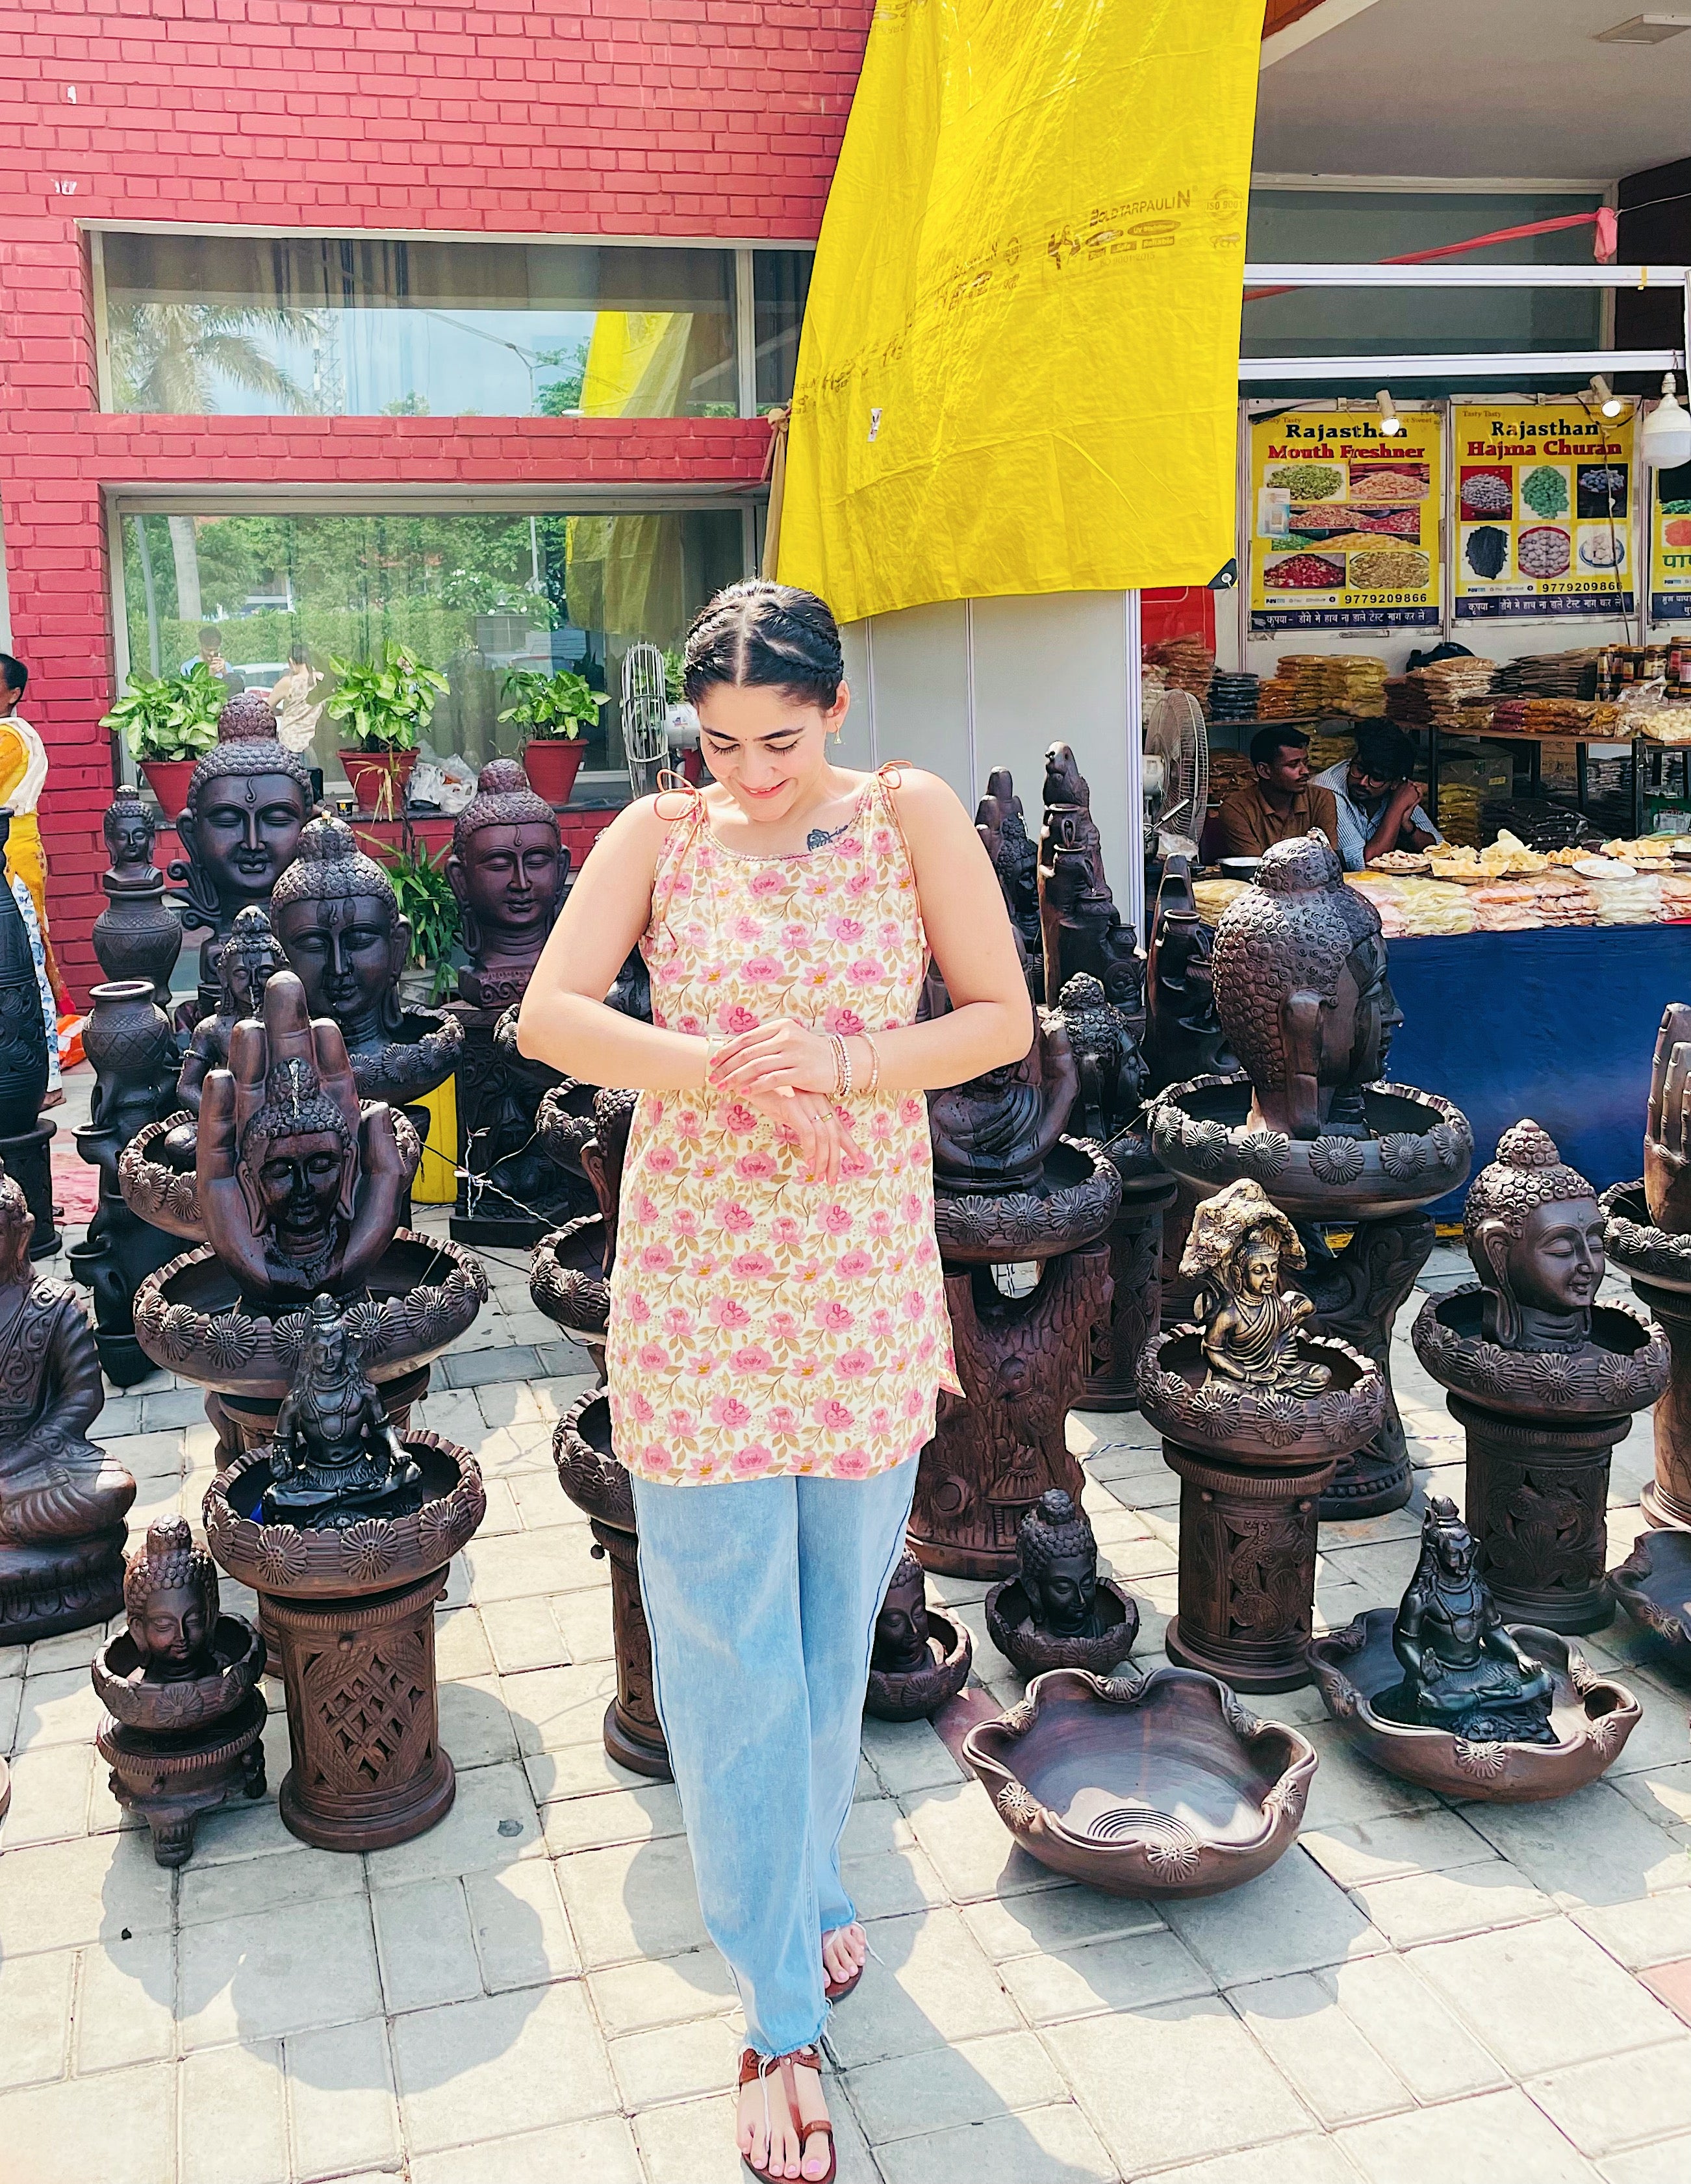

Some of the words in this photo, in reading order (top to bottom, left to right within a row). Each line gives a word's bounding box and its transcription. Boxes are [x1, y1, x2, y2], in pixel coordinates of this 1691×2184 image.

[1206, 201, 1220, 210] ISO
[1490, 418, 1599, 440] Rajasthan
[1267, 443, 1334, 459] Mouth
[1340, 443, 1425, 459] Freshner
[1467, 440, 1537, 460] Hajma
[1543, 438, 1623, 455] Churan
[1542, 581, 1623, 592] 9779209866
[1345, 593, 1427, 604] 9779209866
[1538, 600, 1547, 609] ना
[1599, 598, 1612, 607] कर
[1340, 614, 1350, 622] ना
[1404, 612, 1415, 620] कर
